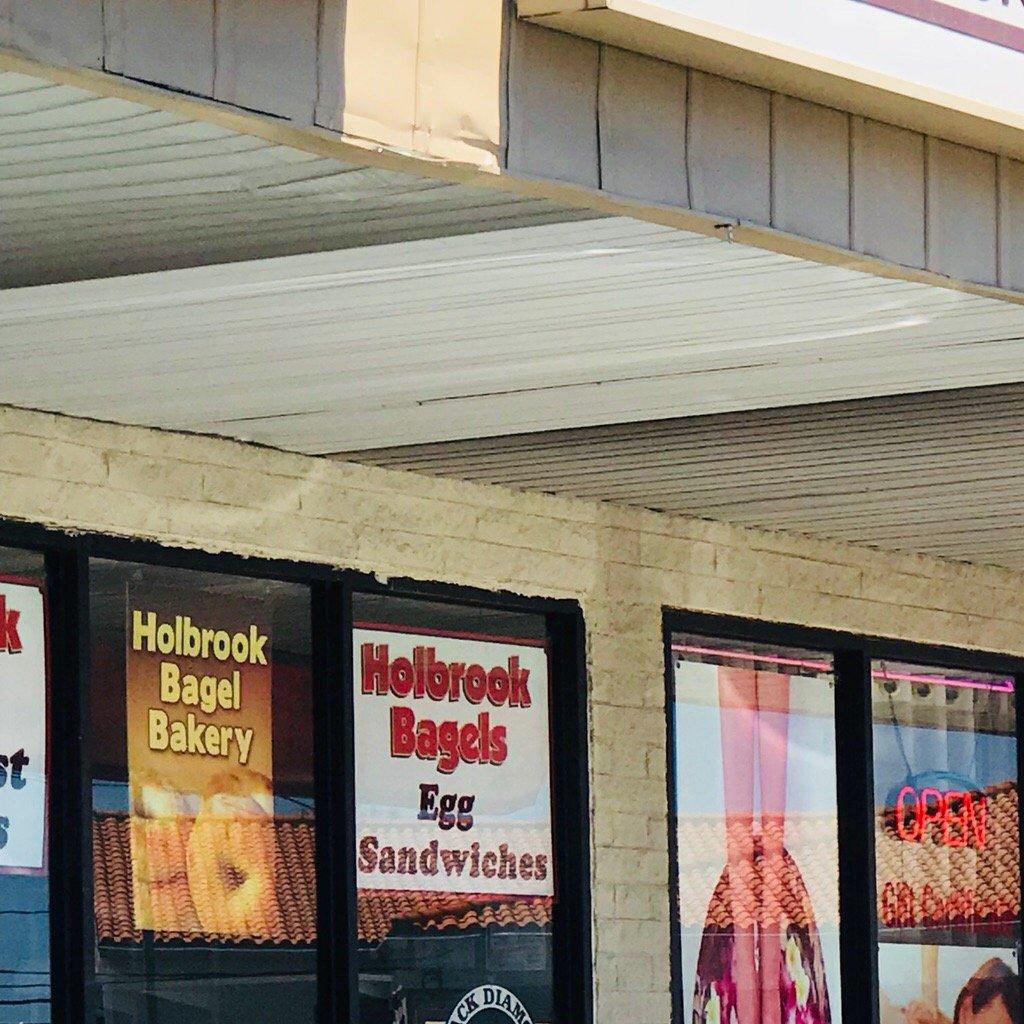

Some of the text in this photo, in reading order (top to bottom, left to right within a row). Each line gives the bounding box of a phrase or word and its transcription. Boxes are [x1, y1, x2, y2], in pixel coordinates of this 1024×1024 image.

[133, 610, 268, 666] Holbrook
[160, 663, 241, 711] Bagel
[361, 642, 531, 707] Holbrook
[147, 708, 253, 764] Bakery
[390, 706, 508, 772] Bagels
[418, 784, 475, 830] Egg
[896, 786, 986, 849] OPEN
[358, 836, 548, 880] Sandwiches
